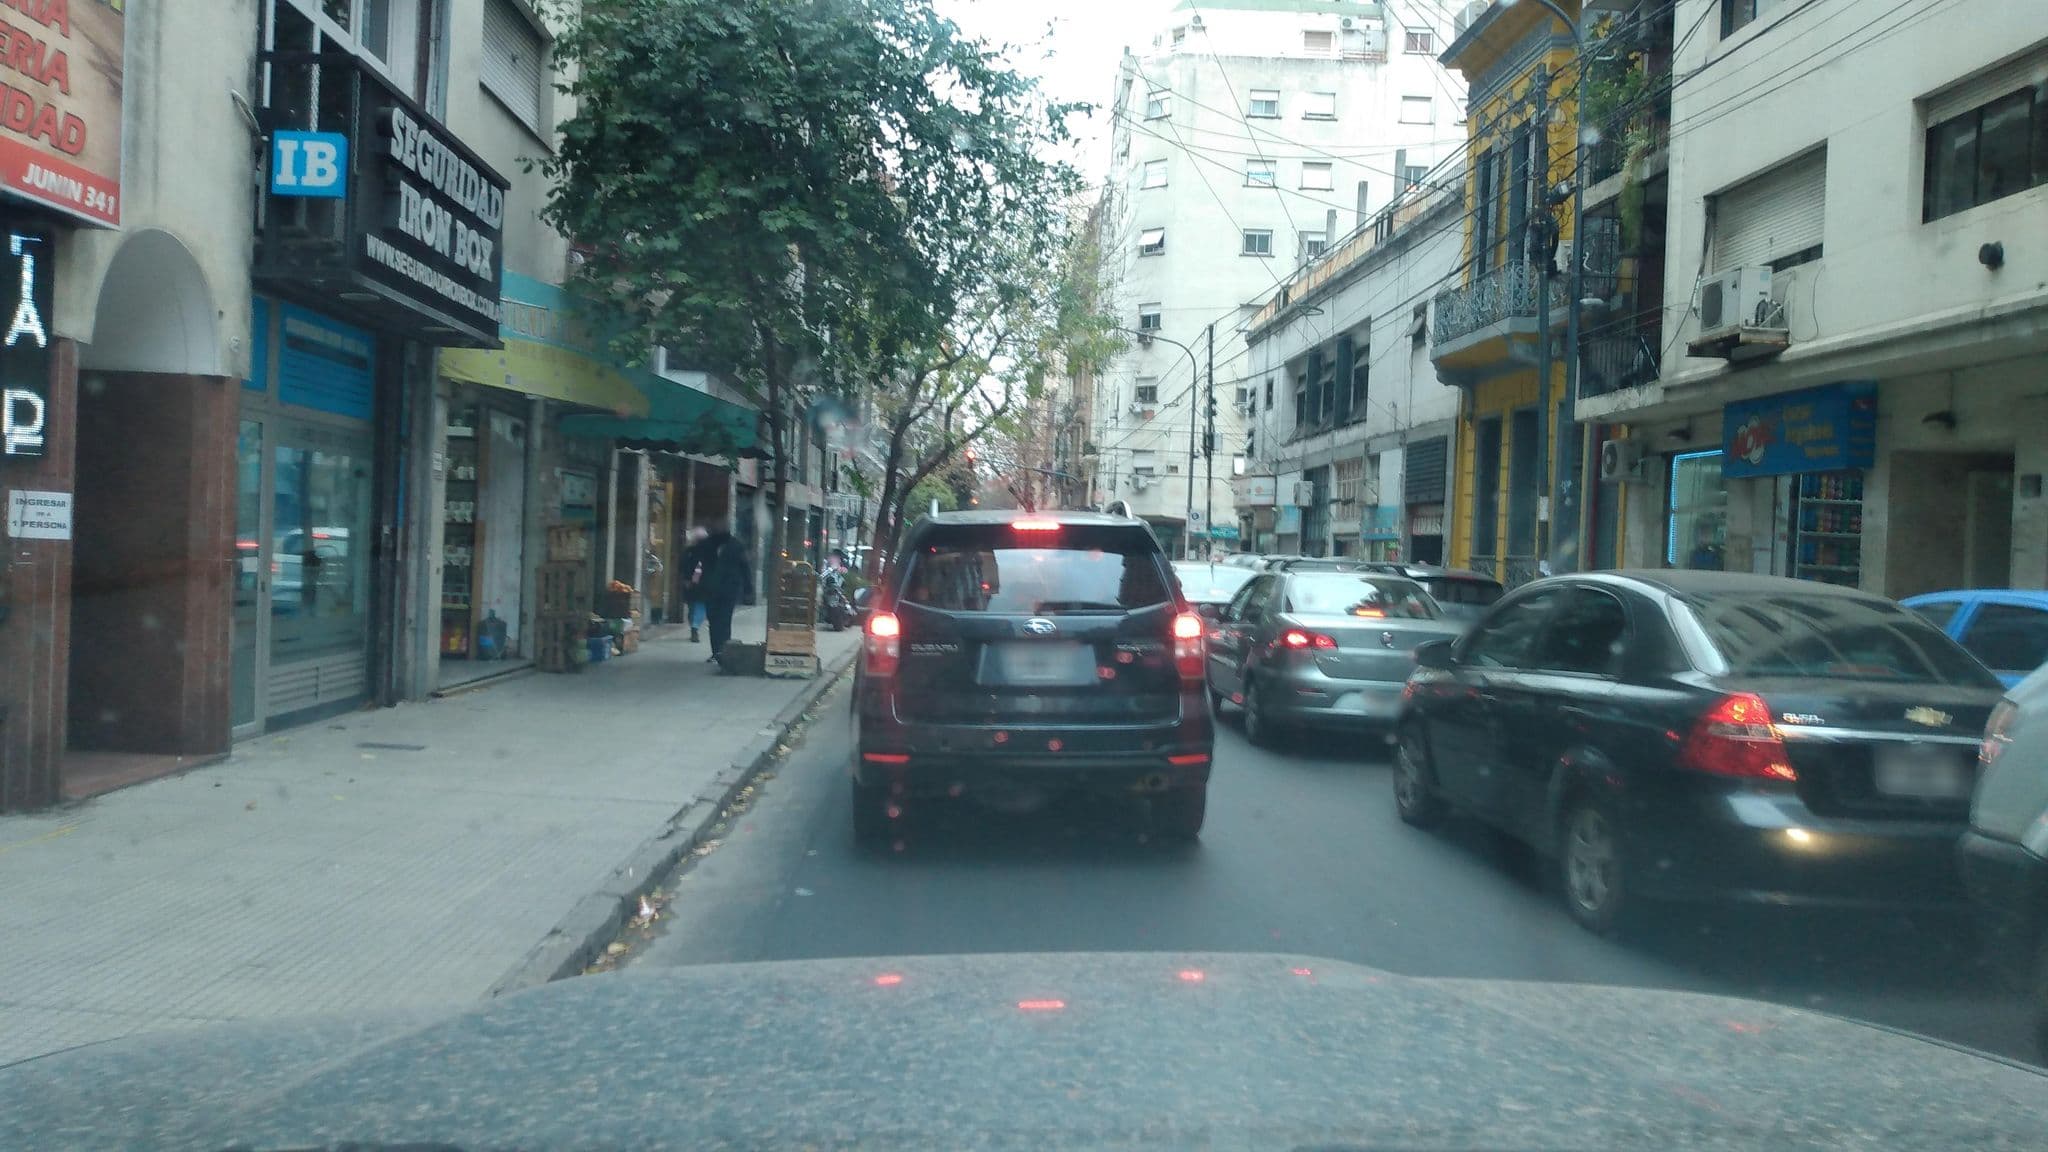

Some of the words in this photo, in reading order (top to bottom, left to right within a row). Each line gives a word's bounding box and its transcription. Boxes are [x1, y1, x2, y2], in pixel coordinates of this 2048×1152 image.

[22, 163, 83, 203] JUNIN
[84, 184, 115, 215] 341
[276, 139, 338, 187] IB
[391, 107, 503, 230] SEGURIDAD
[399, 180, 452, 257] IRON
[454, 219, 493, 282] BOX
[15, 497, 66, 507] INGRESAR
